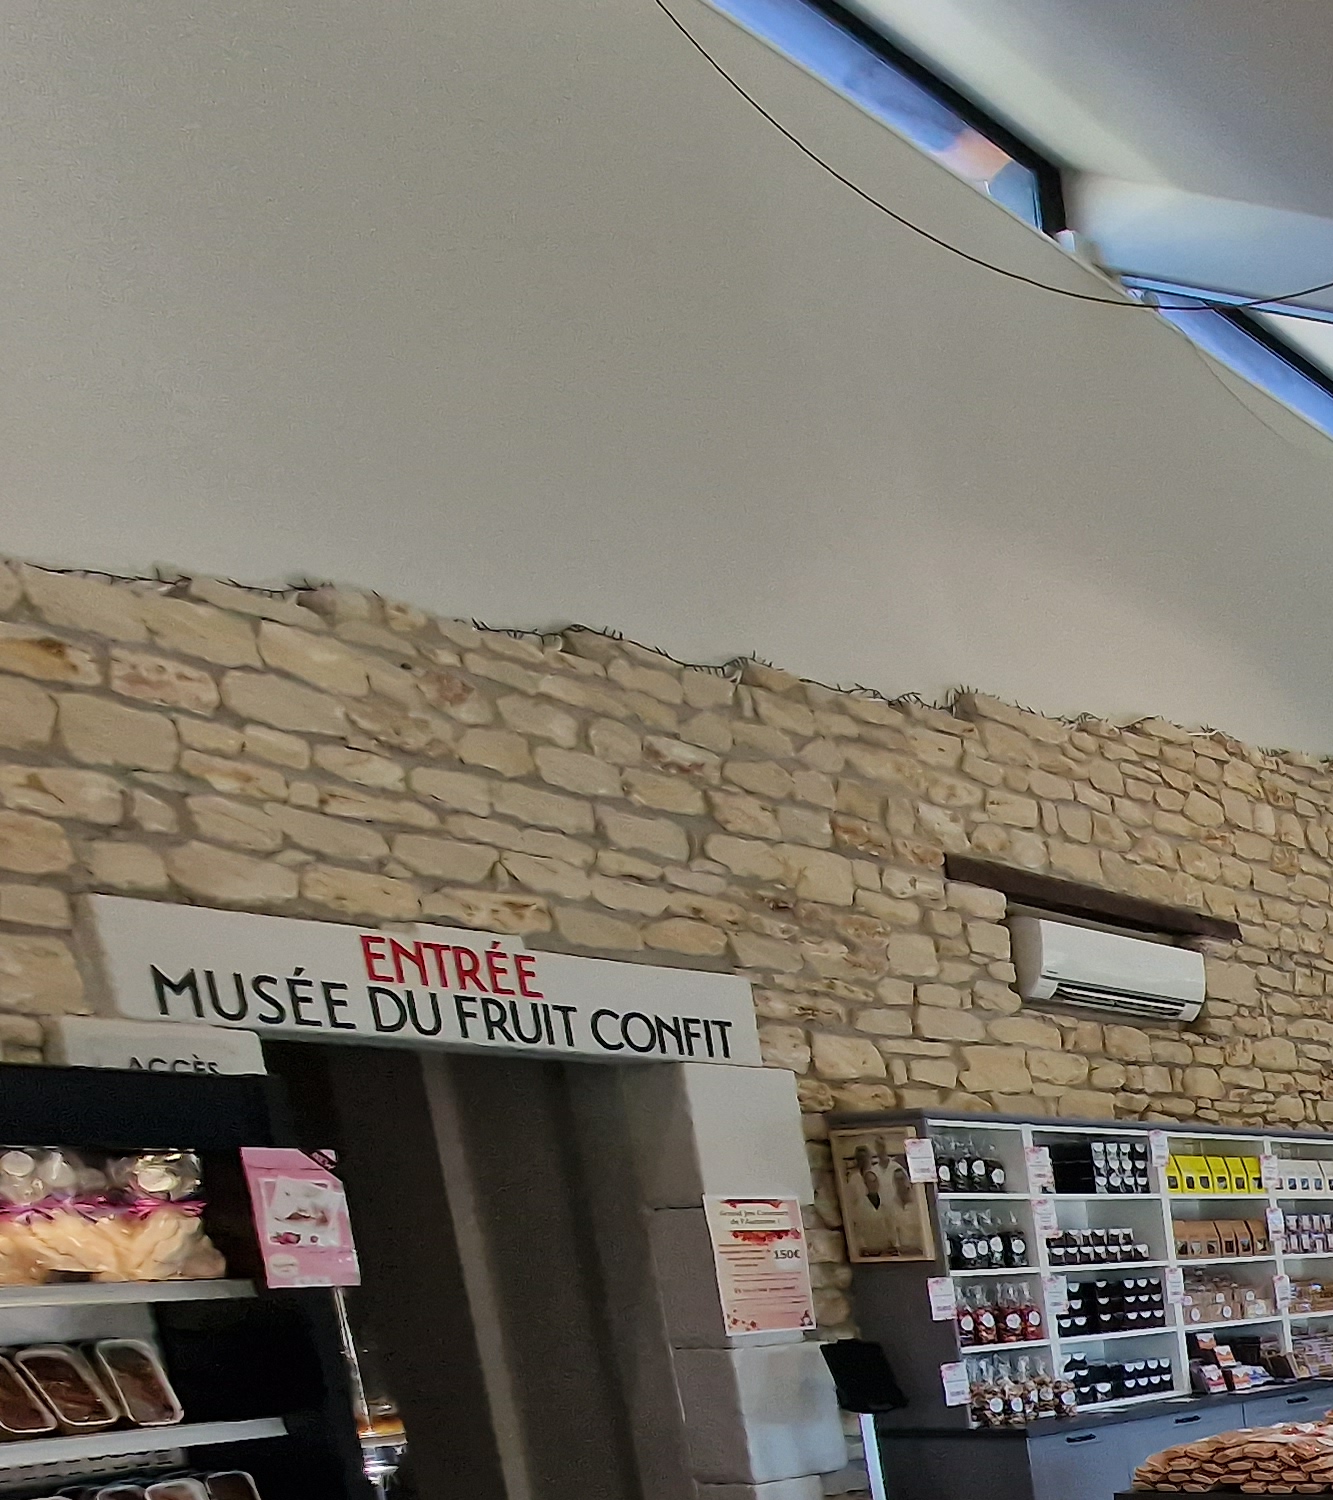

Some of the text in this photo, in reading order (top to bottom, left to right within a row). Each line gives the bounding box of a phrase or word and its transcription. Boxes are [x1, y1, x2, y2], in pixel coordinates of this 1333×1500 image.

[360, 934, 544, 999] ENTRÉE
[150, 966, 733, 1059] MUSÉE DU FRUIT CONFIT
